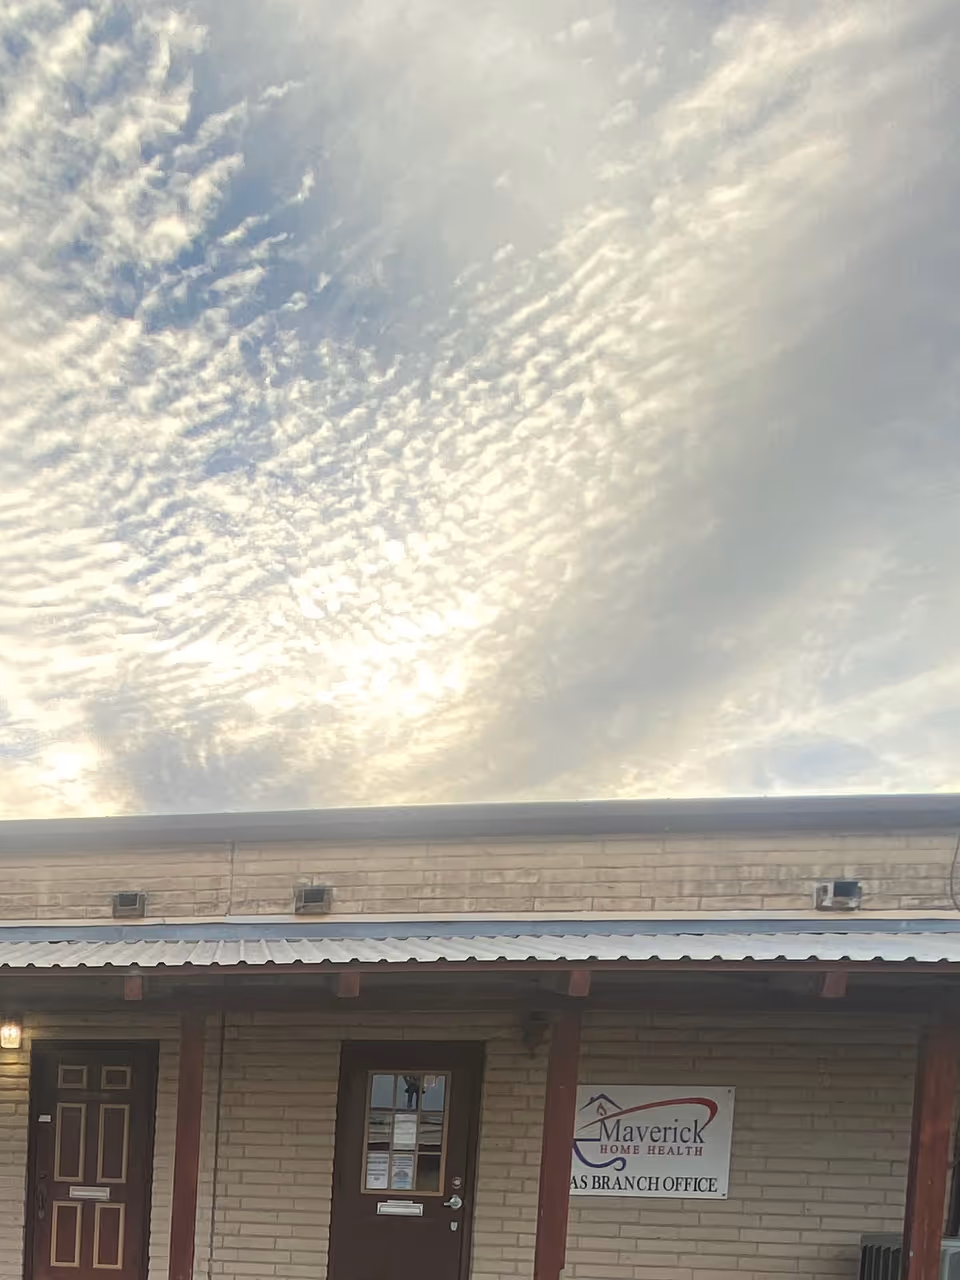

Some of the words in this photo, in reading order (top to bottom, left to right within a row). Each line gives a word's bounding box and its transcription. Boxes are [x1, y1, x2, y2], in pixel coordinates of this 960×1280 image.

[599, 1118, 706, 1144] Maverick
[600, 1144, 640, 1155] HOME
[646, 1145, 704, 1157] HEALTH
[570, 1174, 588, 1190] AS
[591, 1175, 660, 1191] BRANCH
[662, 1176, 718, 1193] OFFICE
